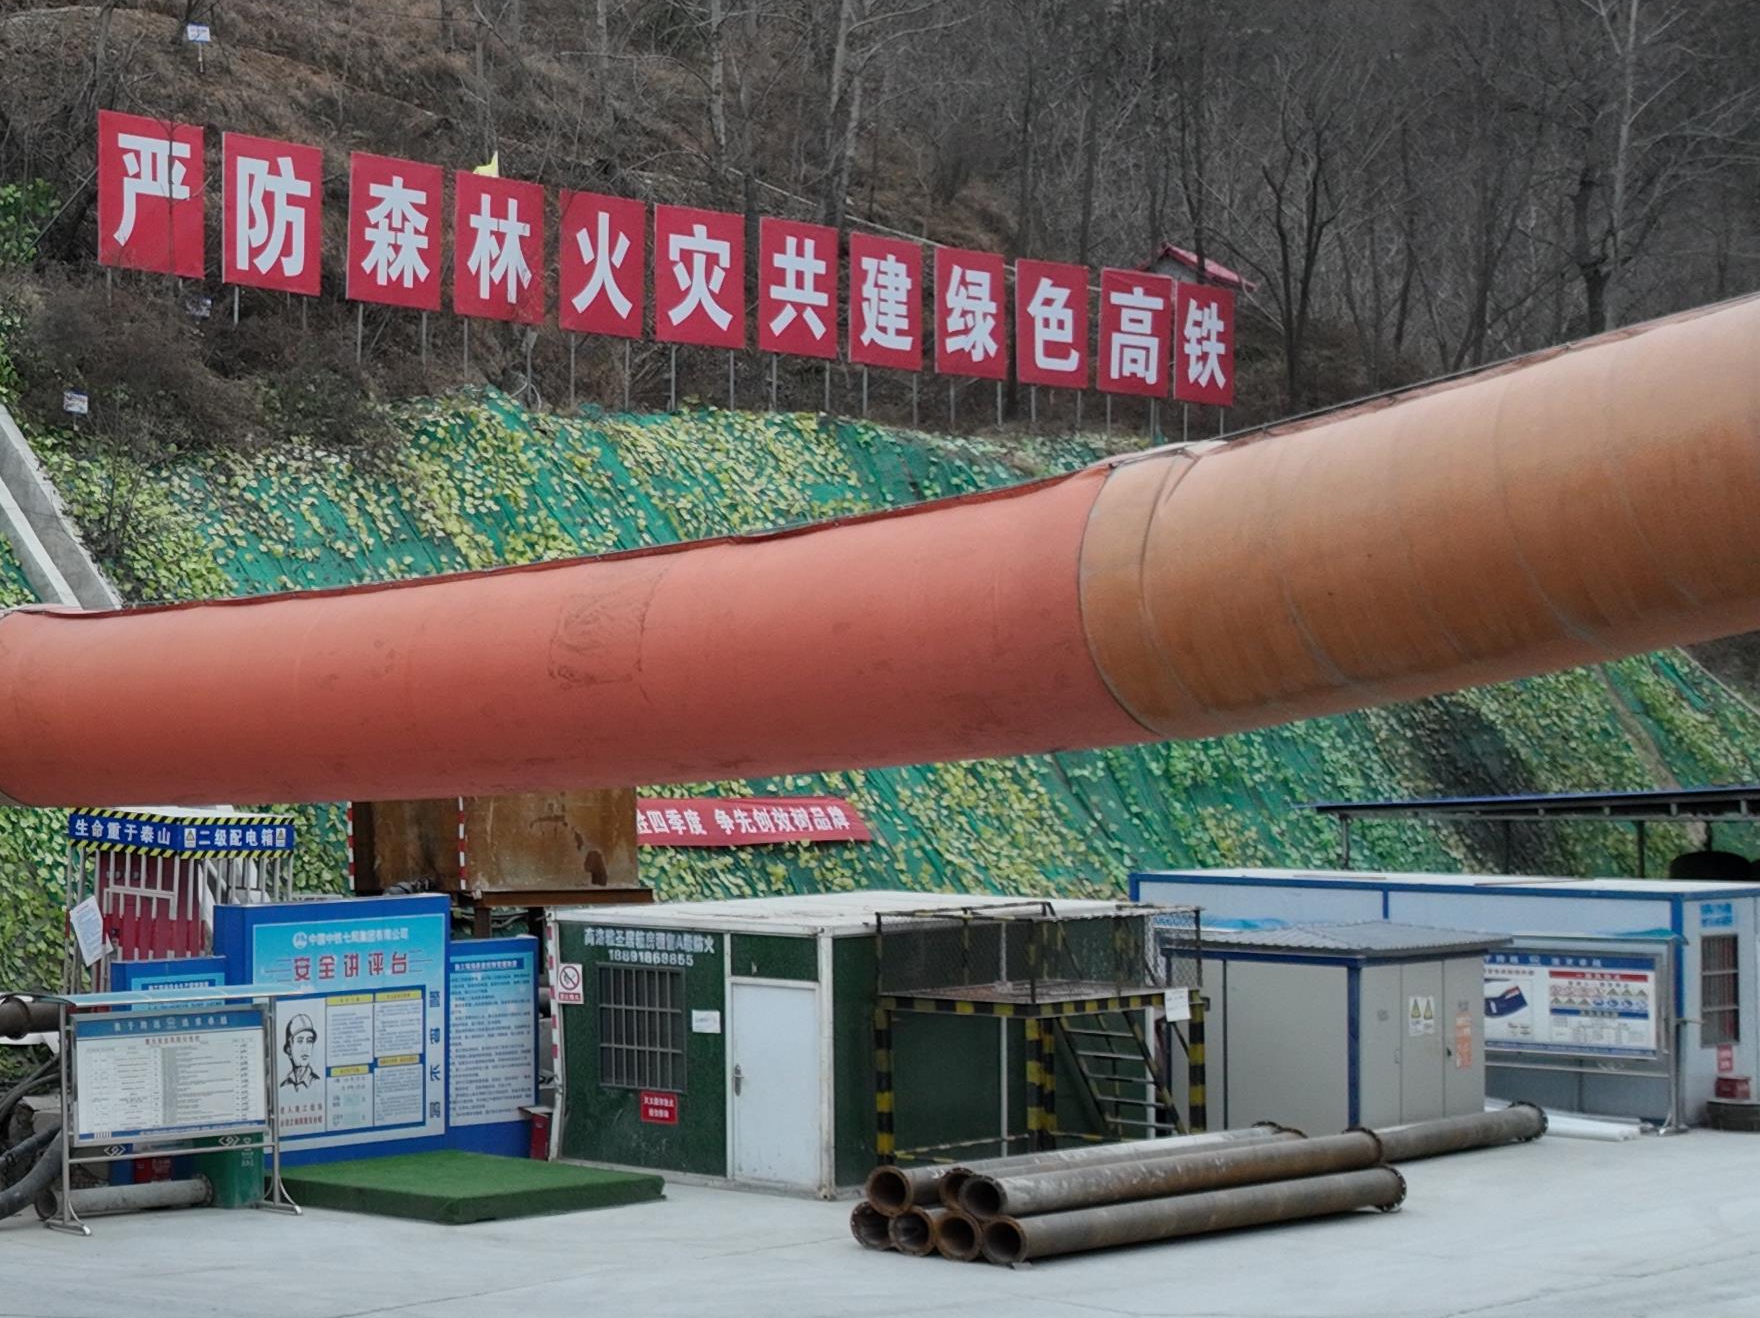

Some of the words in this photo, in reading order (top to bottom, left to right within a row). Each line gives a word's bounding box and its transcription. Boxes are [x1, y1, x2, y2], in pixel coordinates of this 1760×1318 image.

[113, 132, 1229, 390] 严防森林火灾共建绿色高铁
[75, 819, 172, 846] 生命重于泰山
[714, 806, 851, 836] 争先创效树品牌
[199, 829, 275, 848] 二级配电箱
[294, 952, 408, 981] 安全讲评台
